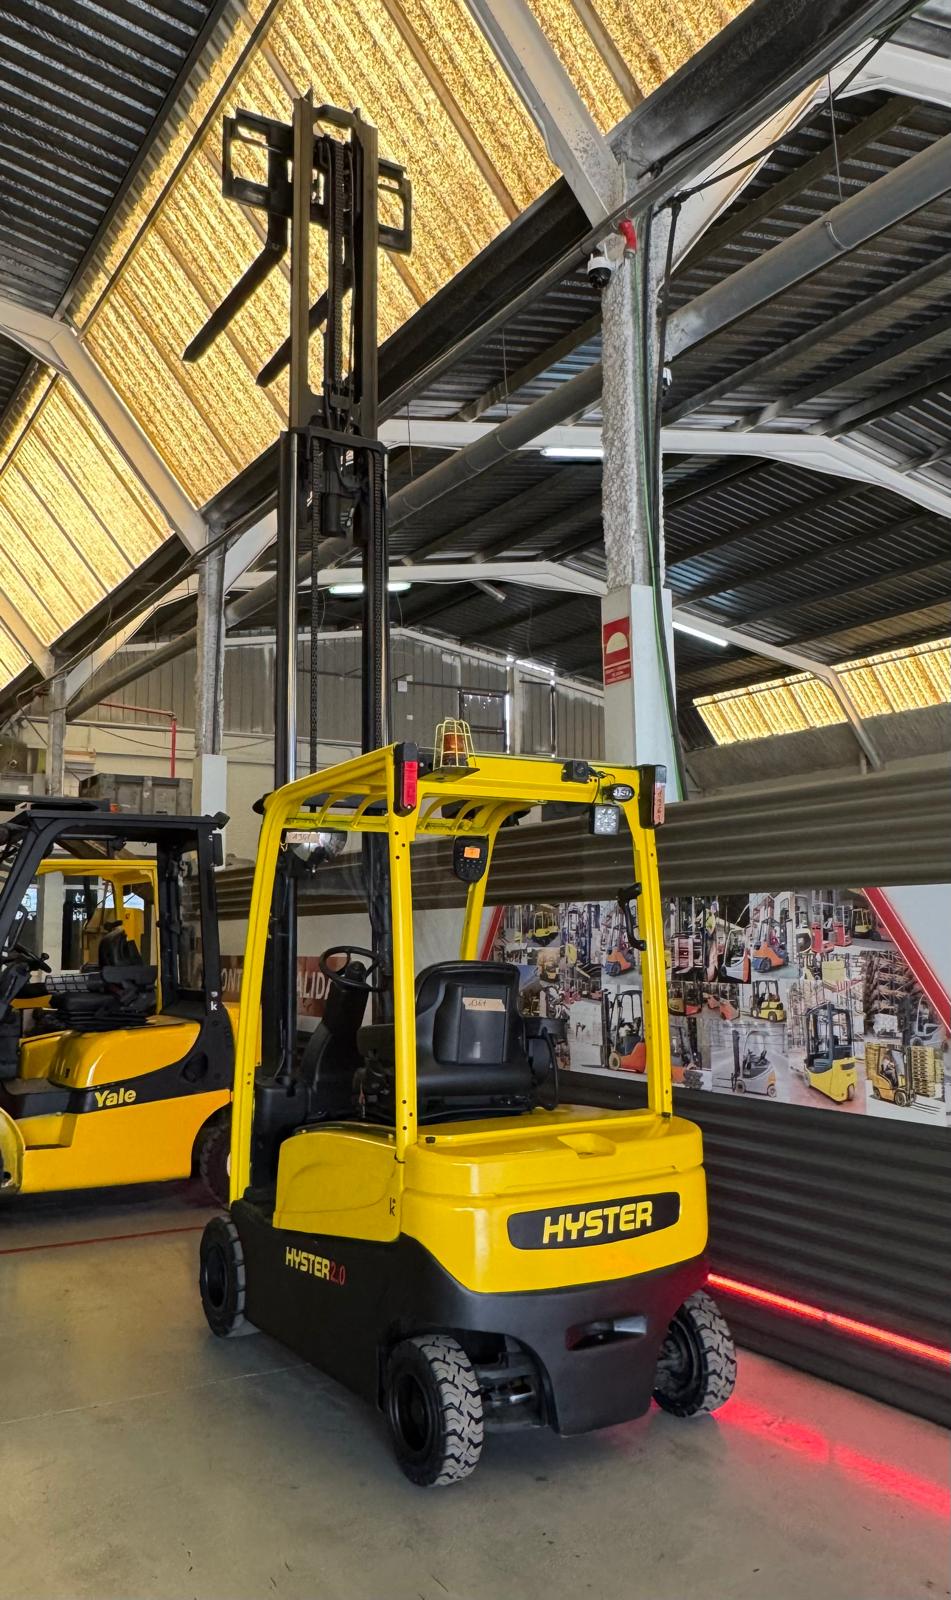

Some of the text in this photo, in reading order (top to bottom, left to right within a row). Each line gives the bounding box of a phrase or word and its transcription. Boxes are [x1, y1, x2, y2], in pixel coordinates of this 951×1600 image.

[94, 1086, 137, 1107] Yale
[542, 1200, 653, 1245] HYSTER
[285, 1245, 330, 1281] HYSTER
